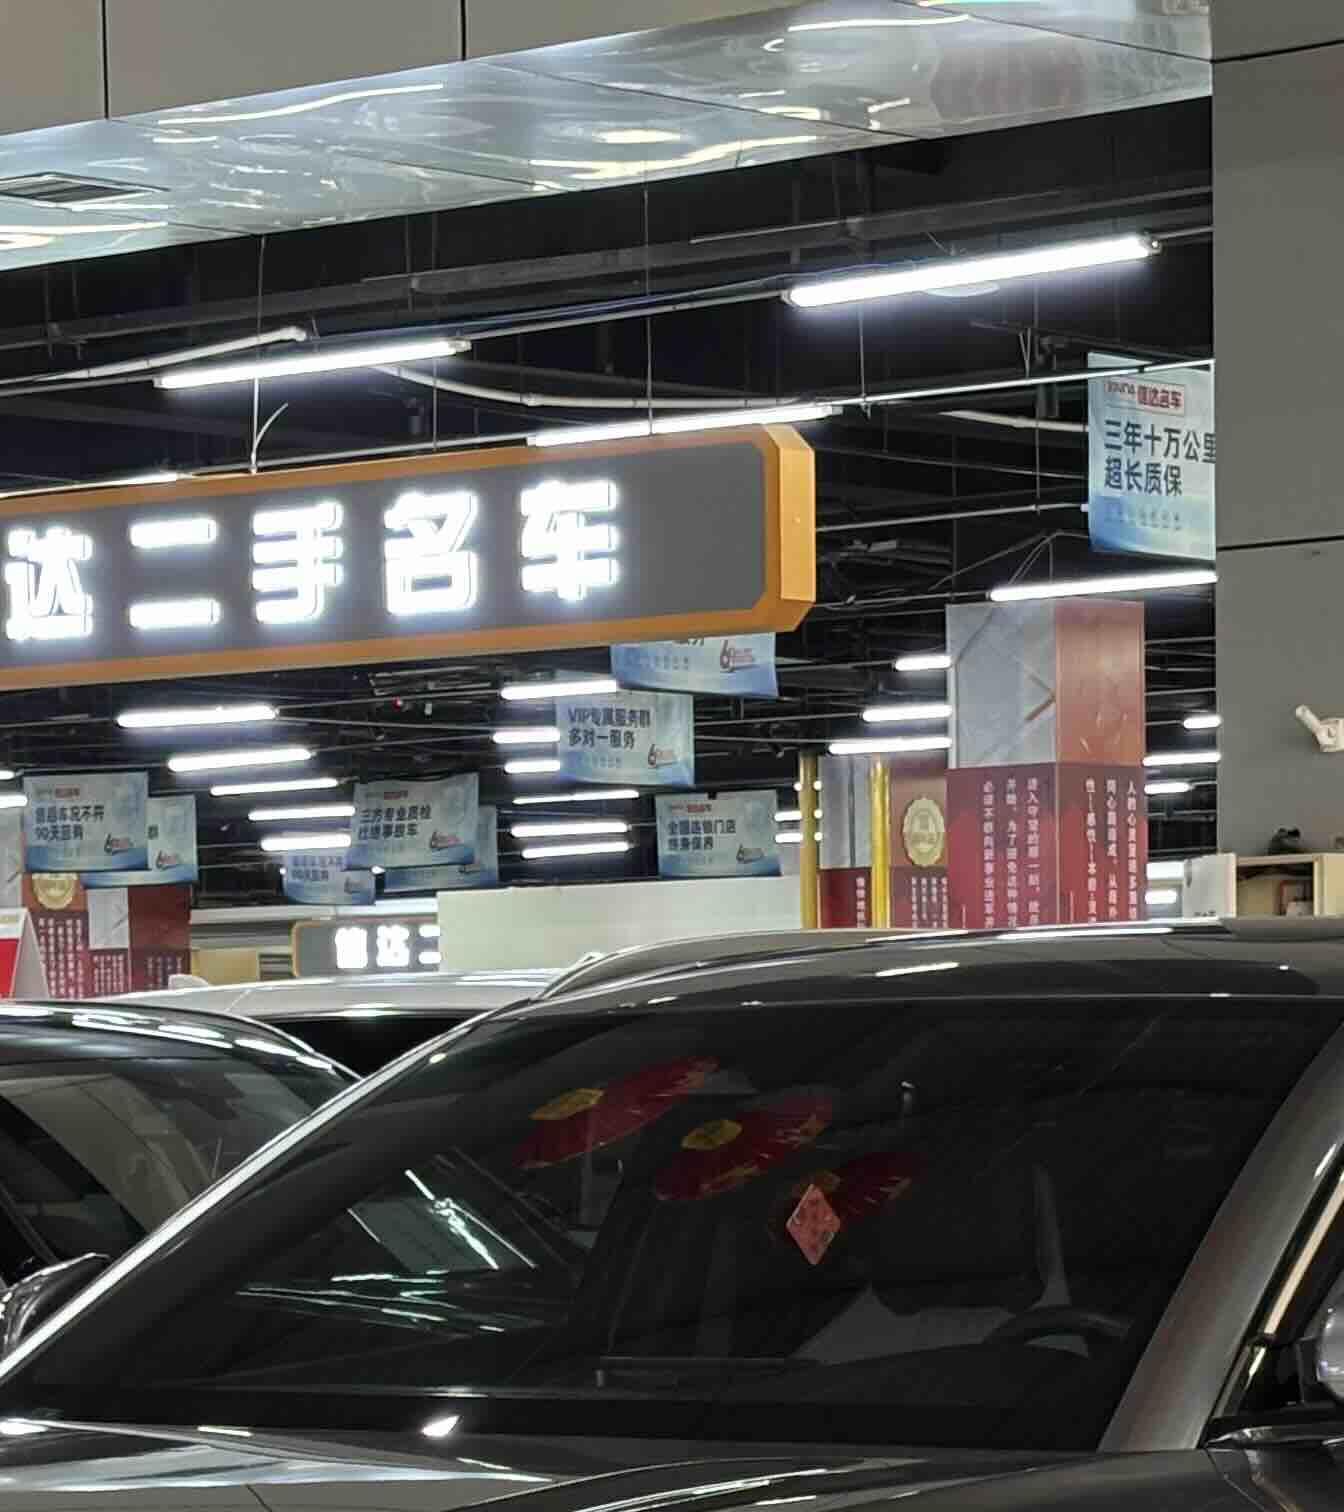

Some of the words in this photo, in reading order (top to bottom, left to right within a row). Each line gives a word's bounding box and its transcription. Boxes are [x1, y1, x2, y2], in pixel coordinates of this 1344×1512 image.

[1104, 456, 1182, 497] 超长质保
[568, 729, 635, 750] 多对一服务
